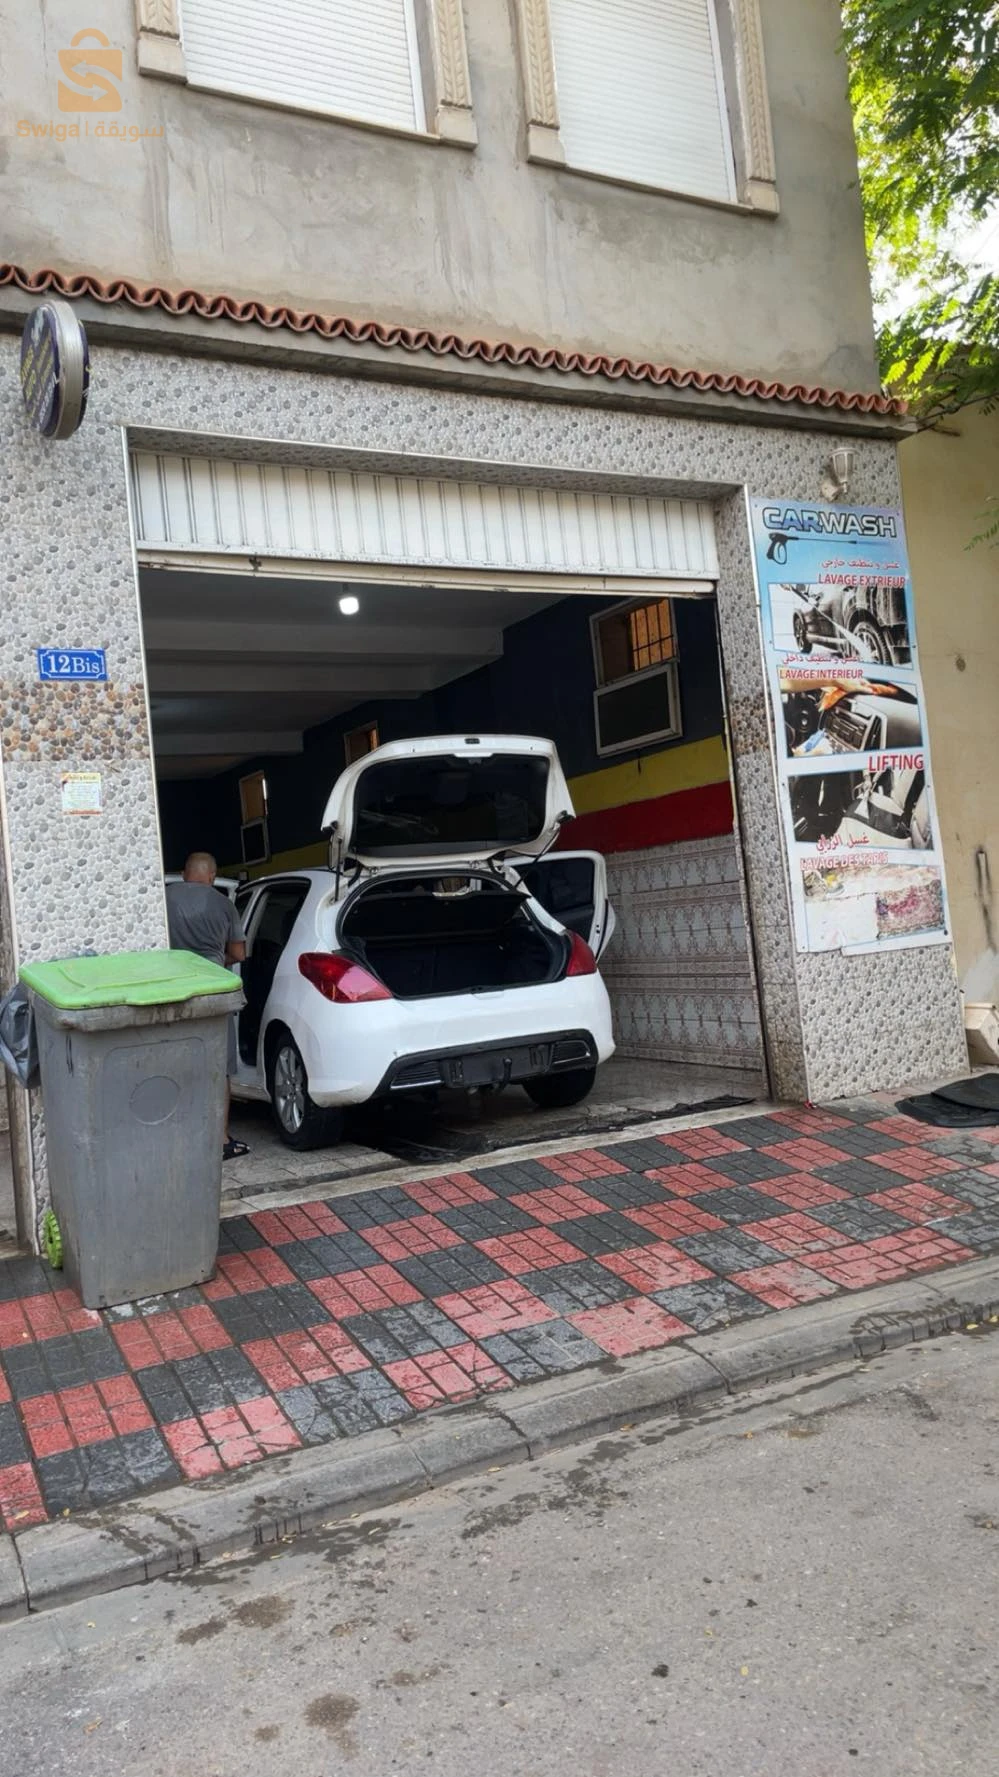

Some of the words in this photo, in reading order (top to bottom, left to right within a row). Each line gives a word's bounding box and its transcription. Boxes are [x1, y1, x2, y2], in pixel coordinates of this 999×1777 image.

[763, 507, 897, 537] CARWASH
[818, 573, 858, 586] LAVAGE
[859, 575, 906, 588] EXTRIEUR
[780, 668, 816, 680] LAVAGE
[816, 668, 864, 680] INTERIEUR
[868, 754, 924, 772] LIFTING
[800, 855, 839, 871] LAVAGE
[840, 853, 860, 868] DES
